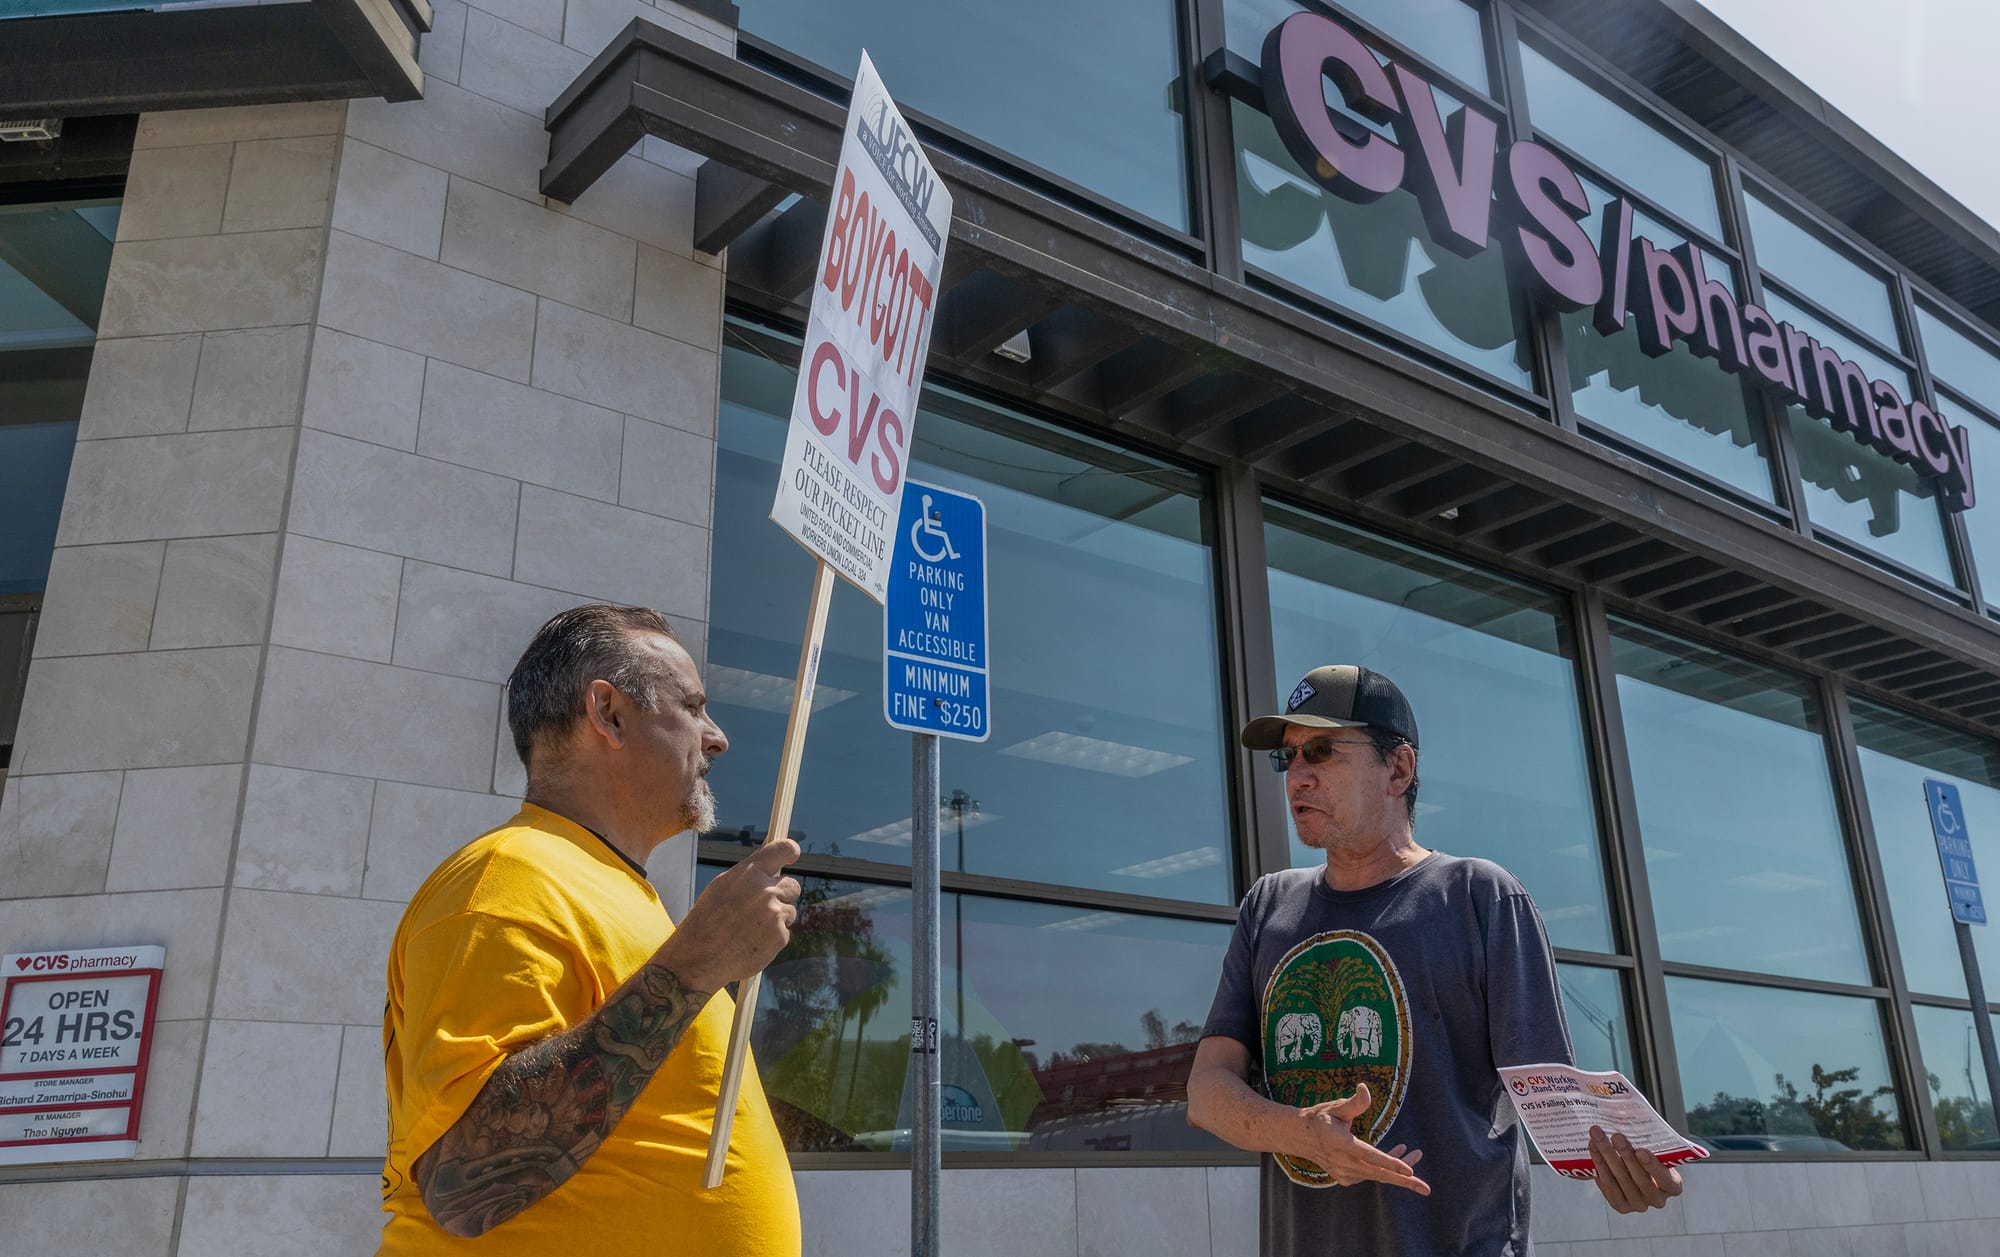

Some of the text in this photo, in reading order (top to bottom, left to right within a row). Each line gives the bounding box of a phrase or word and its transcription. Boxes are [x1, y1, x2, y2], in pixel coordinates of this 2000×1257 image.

[878, 98, 934, 216] UFCW
[862, 129, 938, 246] a VOICE for working America
[823, 165, 933, 387] BOYCOTT
[807, 341, 903, 495] CVS
[803, 440, 887, 532] PLEASE RESPECT
[795, 467, 886, 561] OUR PICKET LINE
[800, 502, 873, 571] UNITED FOOD AND COMMERCIAL
[801, 523, 867, 582] WORKERS UNION LOCAL 324
[909, 561, 964, 591] PARKING
[920, 587, 954, 611] ONLY
[924, 610, 949, 633] VAN
[899, 628, 976, 662] ACCESSIBLE
[905, 664, 970, 698] MINIMUM
[894, 692, 981, 730] FINE $250
[33, 954, 137, 971] CVS pharmacy
[49, 989, 109, 1010] OPEN
[1, 1009, 141, 1047] 24 HRS.
[19, 1046, 120, 1063] 7 DAYS A WEEK
[34, 1077, 94, 1088] STORE MANAGER
[1527, 1075, 1545, 1085] CVS
[1531, 1085, 1552, 1093] Stand
[1604, 1081, 1630, 1095] 324
[36, 1089, 128, 1103] Zamarripa-Sinohui
[1535, 1101, 1541, 1109] is
[1542, 1100, 1565, 1109] Failing
[34, 1112, 81, 1121] RX MANAGER
[23, 1126, 88, 1138] Thao Nguyen
